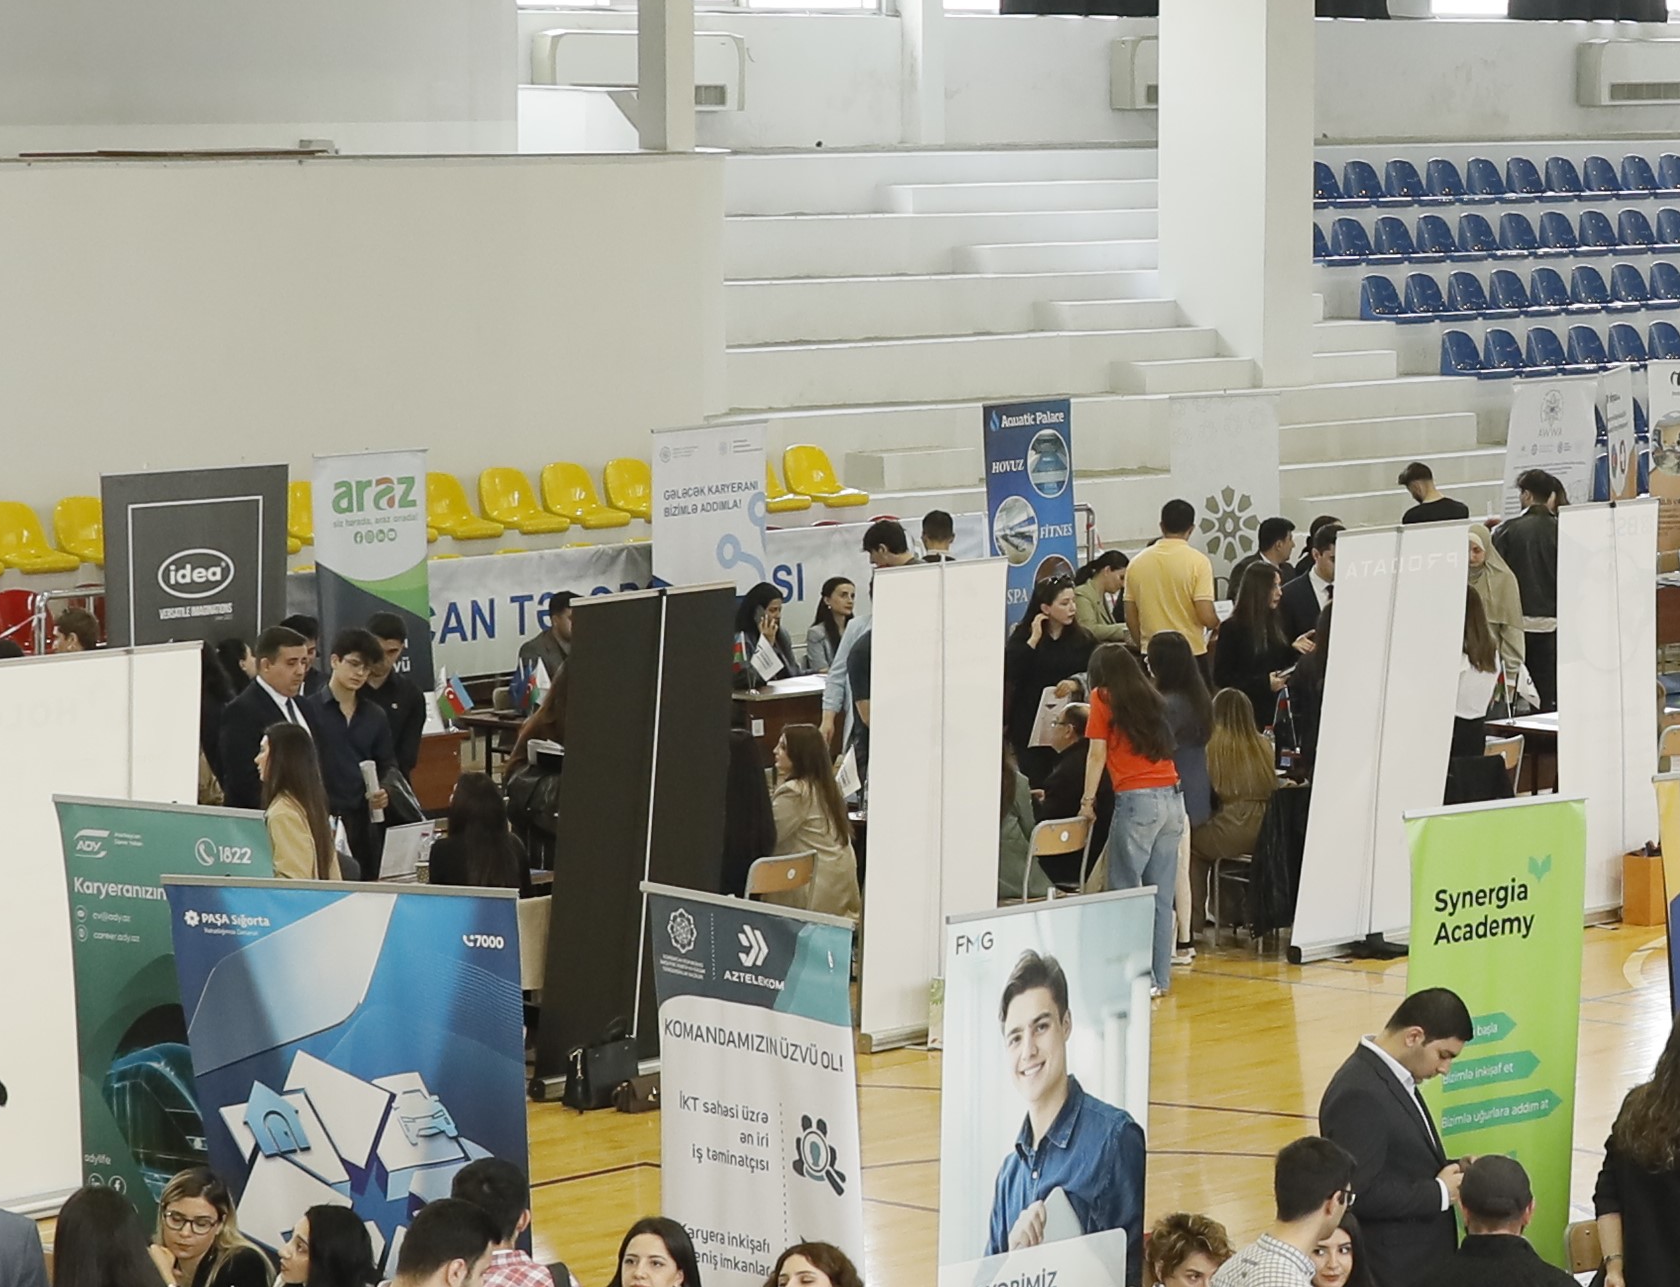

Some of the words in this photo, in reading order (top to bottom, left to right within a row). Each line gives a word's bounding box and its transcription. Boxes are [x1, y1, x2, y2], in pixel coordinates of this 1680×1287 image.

[1001, 413, 1035, 428] Aquatic
[1037, 411, 1064, 423] Palace
[992, 459, 1025, 473] HOVUZ
[331, 476, 417, 515] araz
[708, 481, 758, 495] KARYERANI
[169, 564, 222, 585] idea
[1007, 588, 1028, 604] SPA
[76, 841, 101, 852] ADY
[219, 846, 251, 863] 1822
[74, 877, 168, 902] Karyeranızın
[1435, 878, 1528, 916] Synergia
[202, 912, 229, 926] PAŞA
[232, 916, 271, 929] Sığorta
[1434, 914, 1535, 945] Academy
[474, 934, 504, 949] 7000
[956, 931, 994, 955] FMG
[724, 969, 785, 991] AZTELEKOM
[1477, 1021, 1498, 1038] başla
[664, 1018, 778, 1058] KOMANDAMIZIN
[779, 1036, 819, 1066] ÜZVÜ
[821, 1050, 844, 1072] OL!
[1504, 1062, 1514, 1074] et
[679, 1091, 699, 1112] İKT
[702, 1099, 739, 1120] sahəsi
[741, 1107, 769, 1124] üzrə
[740, 1131, 754, 1143] ən
[758, 1133, 769, 1147] iri
[692, 1144, 703, 1163] iş
[707, 1146, 769, 1173] təminatçısı
[728, 1232, 770, 1255] inkişafı
[694, 1251, 718, 1271] eniş
